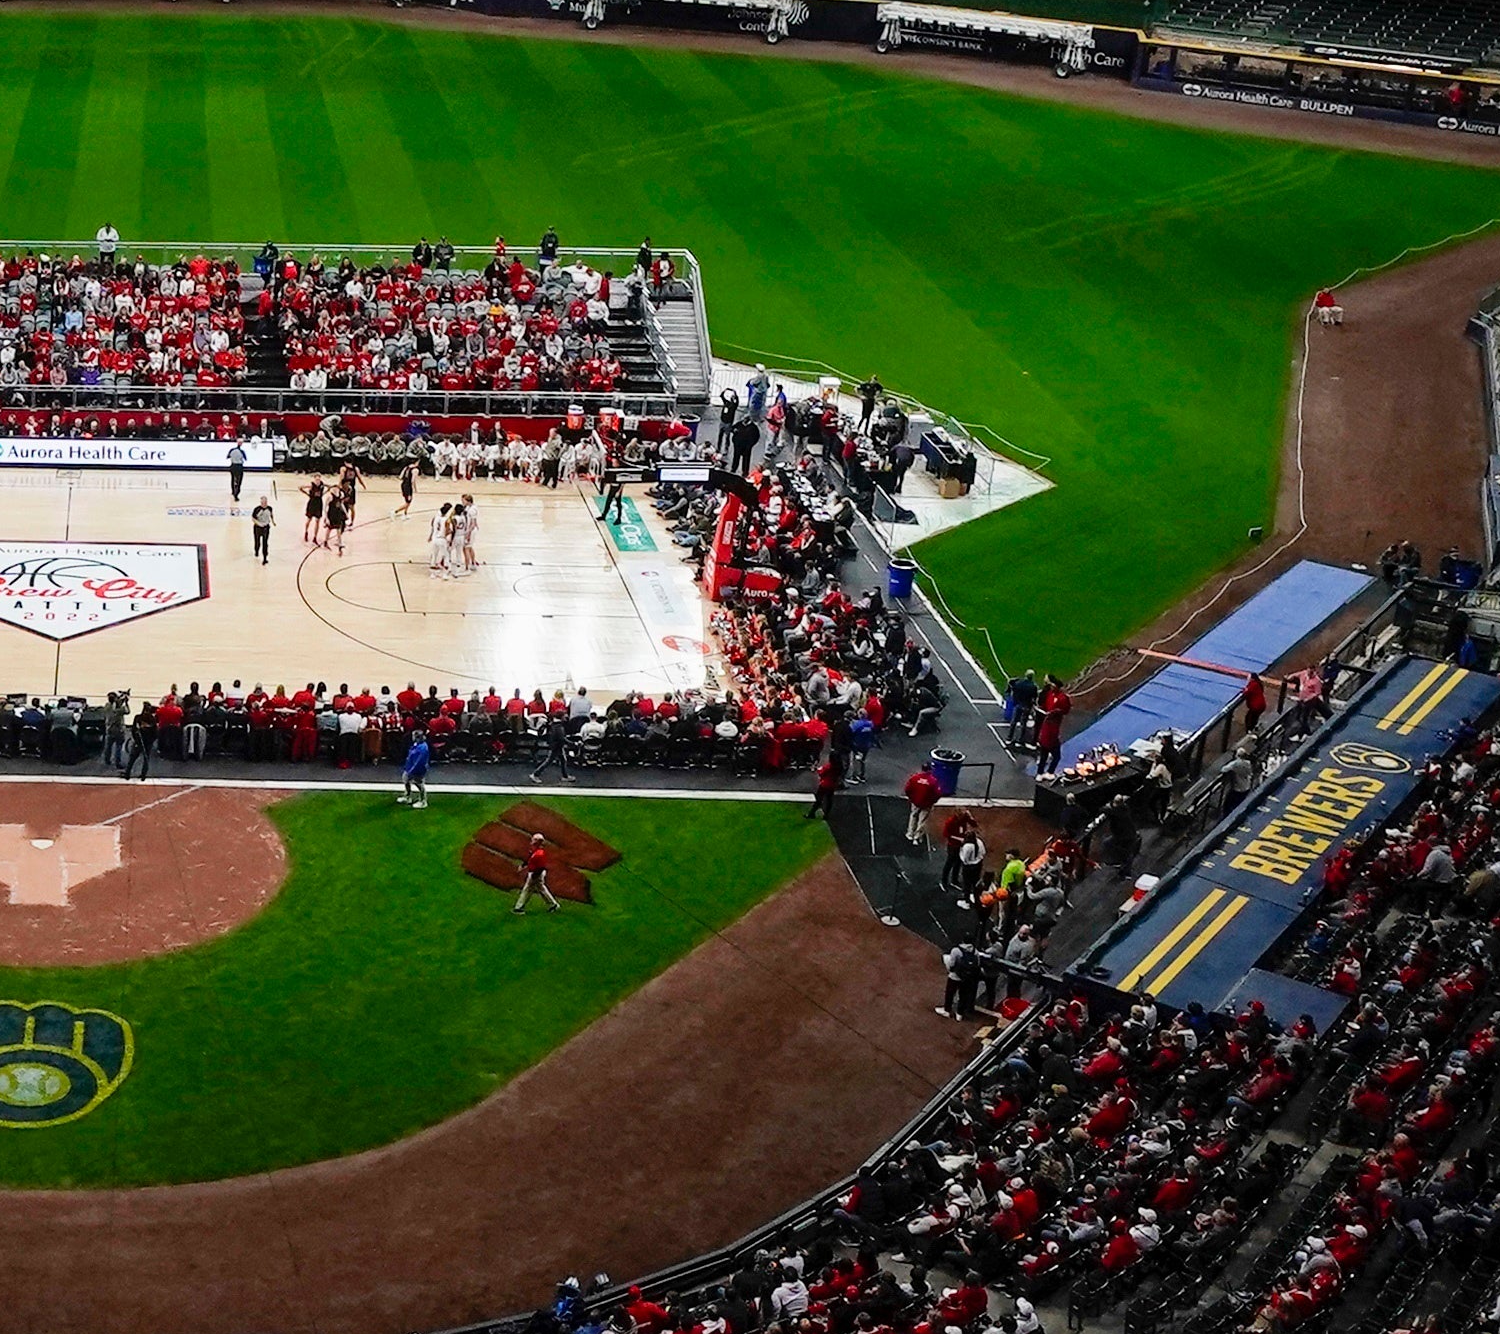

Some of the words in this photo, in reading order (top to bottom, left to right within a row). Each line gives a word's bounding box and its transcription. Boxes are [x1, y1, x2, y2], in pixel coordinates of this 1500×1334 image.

[1201, 85, 1235, 101] Aurora
[1236, 89, 1269, 105] Health
[1270, 93, 1294, 109] Care
[1300, 99, 1354, 116] BULLPEN
[1460, 120, 1496, 136] Aurora
[7, 445, 64, 461] Aurora
[69, 445, 123, 461] Health
[128, 446, 167, 462] Care
[82, 577, 182, 604] City
[23, 611, 100, 622] 2022
[1201, 825, 1252, 869] HOME
[1257, 794, 1281, 813] OF
[1229, 767, 1386, 886] BREWERS
